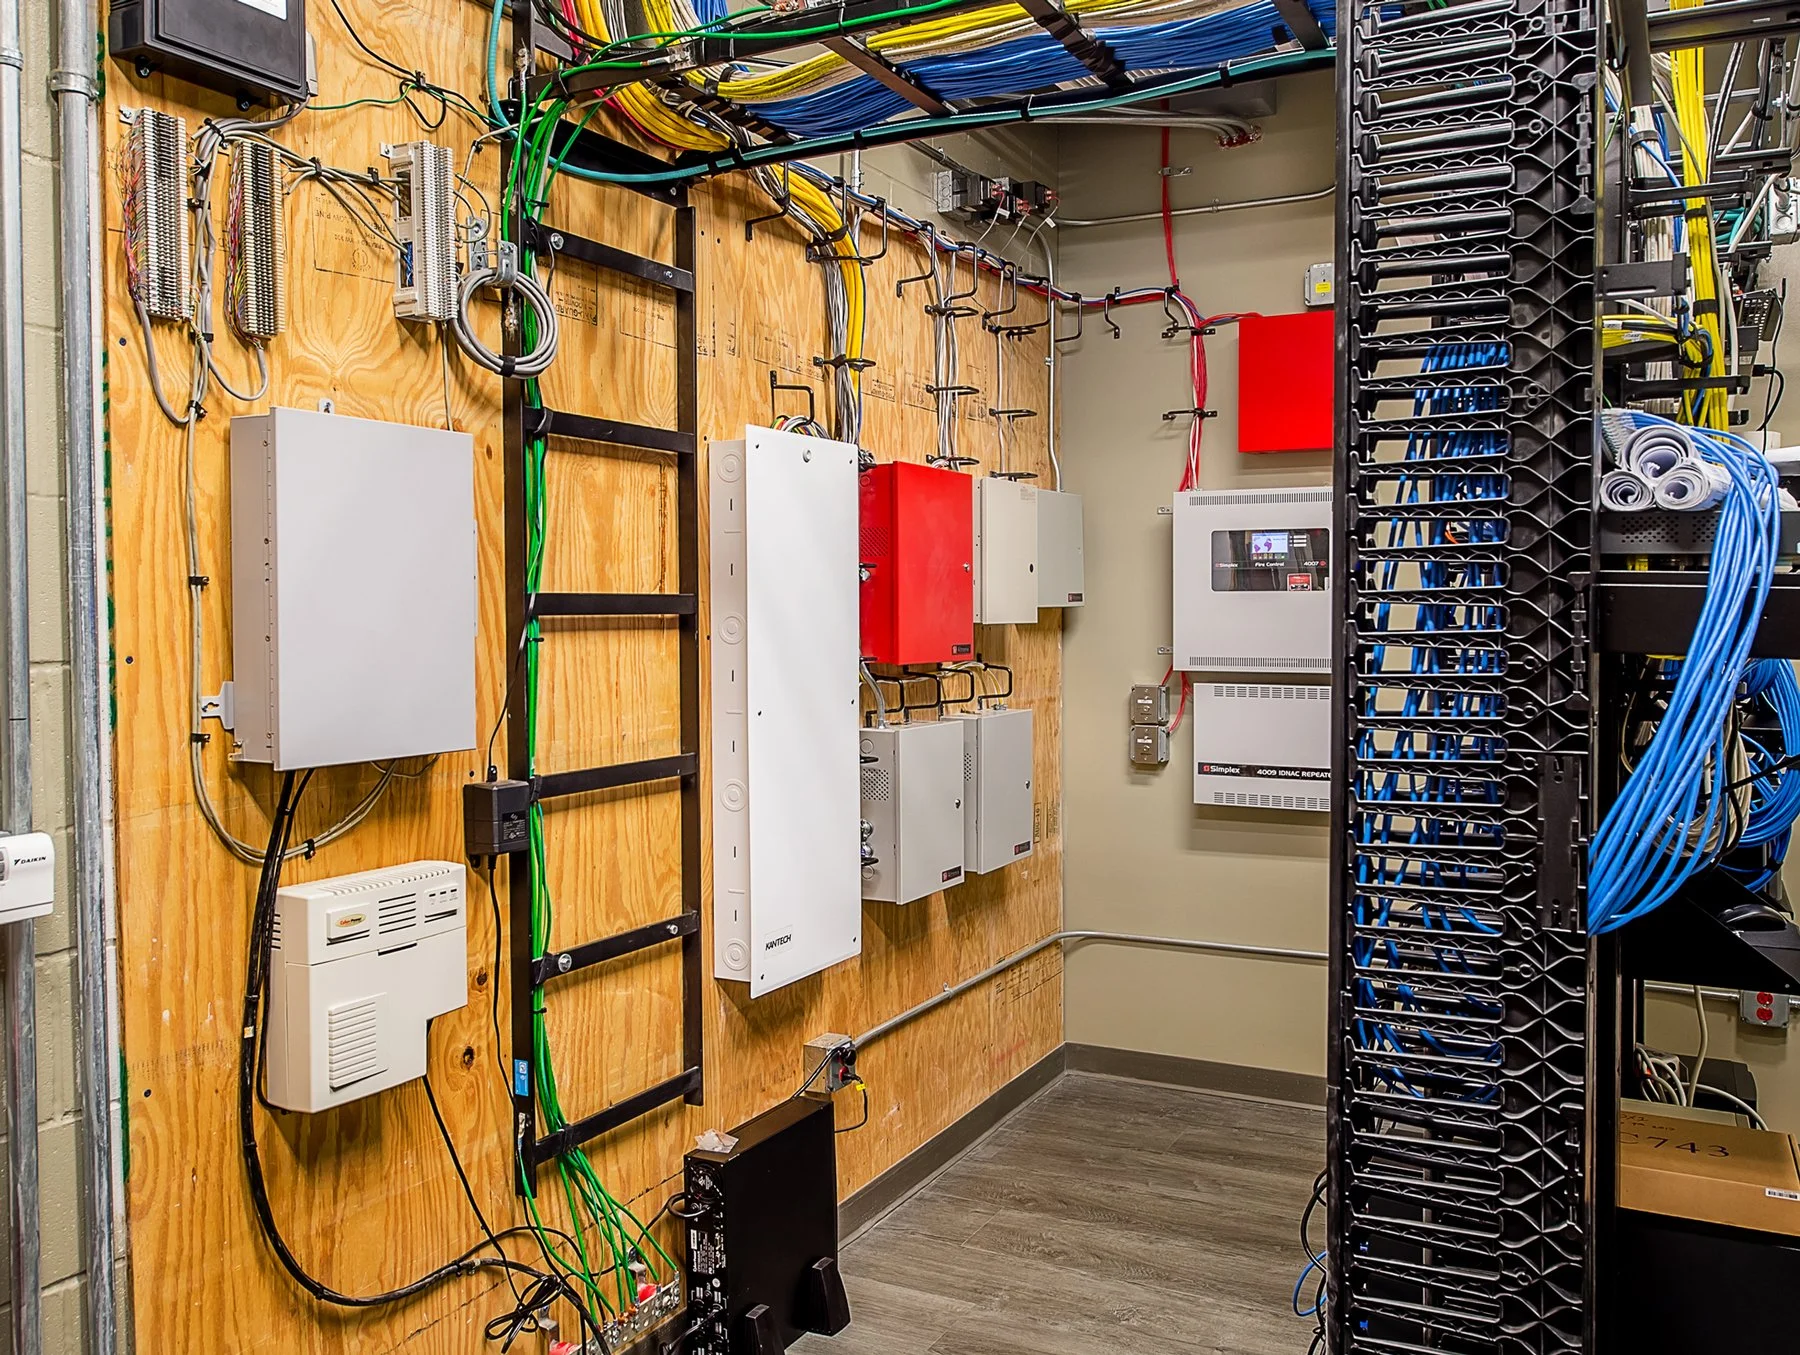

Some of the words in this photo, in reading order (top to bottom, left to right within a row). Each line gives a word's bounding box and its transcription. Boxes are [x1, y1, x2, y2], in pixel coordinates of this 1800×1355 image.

[1210, 765, 1240, 774] Simplex
[20, 856, 47, 865] DAIKIN
[765, 933, 792, 951] KANTECH
